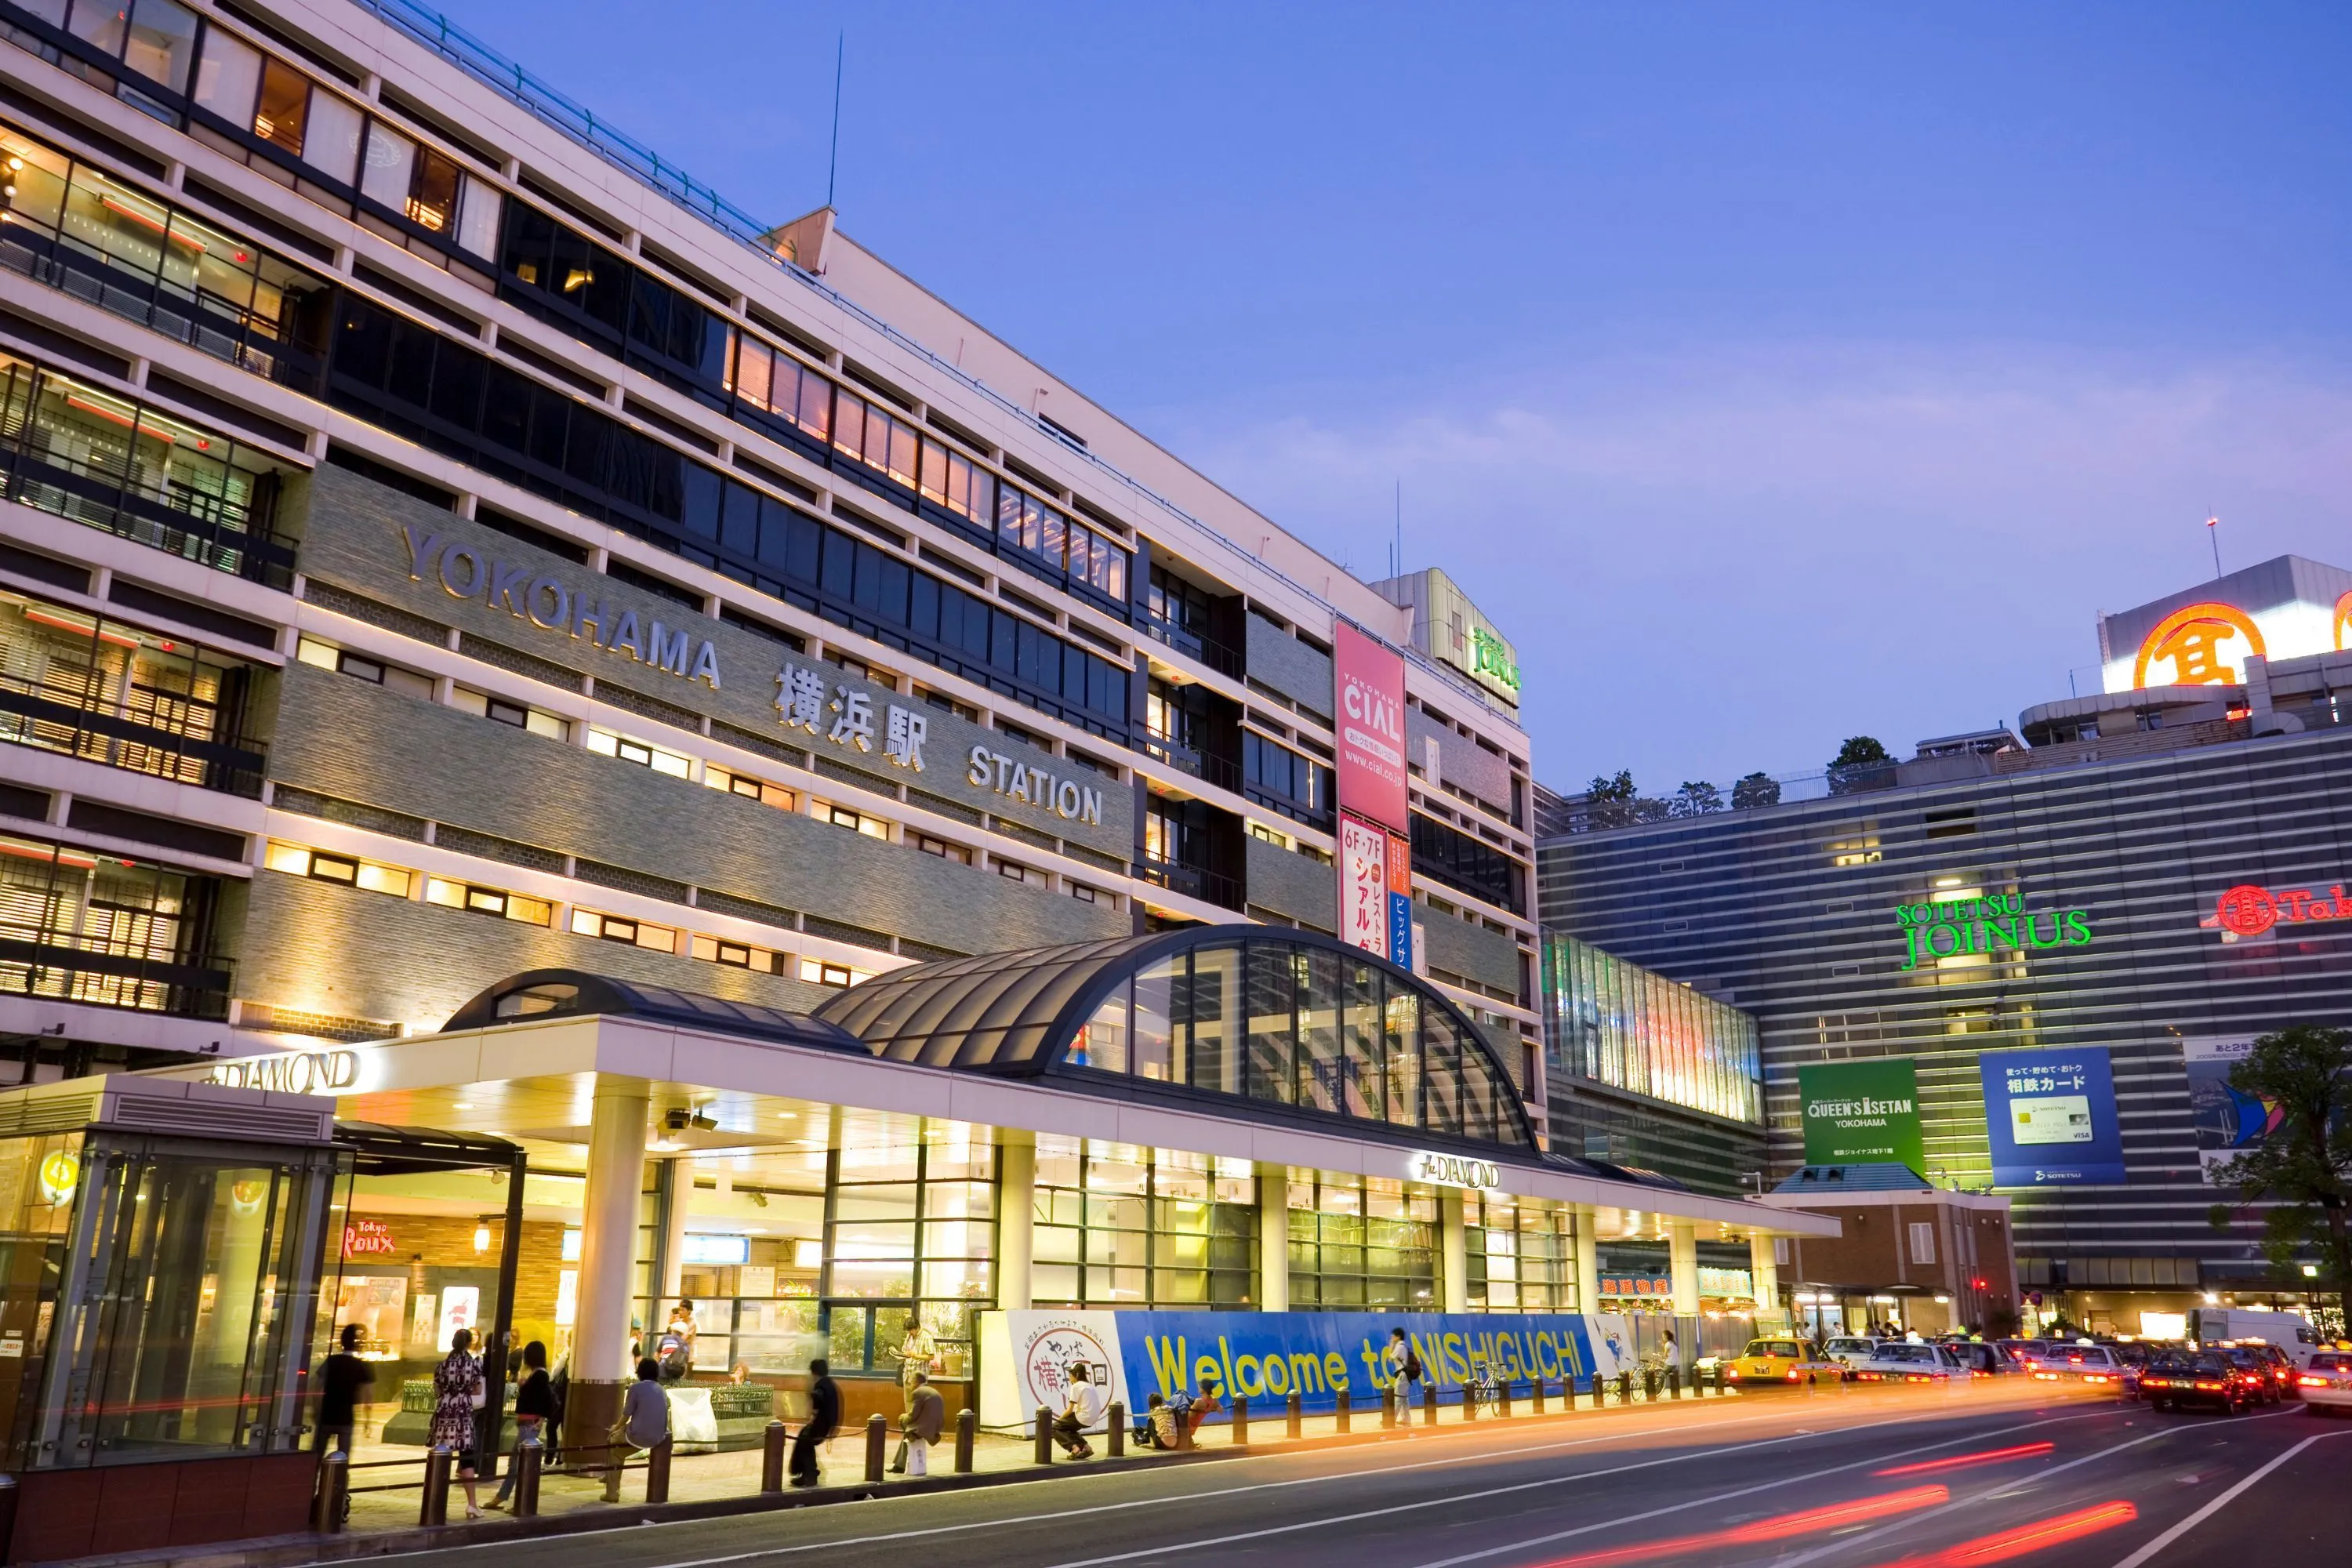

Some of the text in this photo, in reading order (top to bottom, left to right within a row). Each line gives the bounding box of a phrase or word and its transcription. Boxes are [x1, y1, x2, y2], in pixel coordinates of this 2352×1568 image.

[402, 524, 1102, 826] YOKOHAMA 横浜駅 STATION
[1345, 672, 1399, 709] YOKOHAMA
[1345, 684, 1400, 743] CIAL
[1345, 750, 1402, 787] www.cial.co.jp
[1895, 893, 2024, 927] SOTETSU
[1900, 910, 2092, 971] JOINUS
[225, 1051, 361, 1095] DIAMOND
[2007, 1076, 2085, 1094] 相鉄カード
[1808, 1102, 1863, 1118] QUEEN'S
[1835, 1119, 1887, 1128] YOKOHAMA
[1437, 1156, 1500, 1188] DIAMOND
[358, 1221, 387, 1236] Tokyo
[1145, 1335, 1350, 1402] Welcome
[1411, 1330, 1583, 1386] NISHIGUCHI
